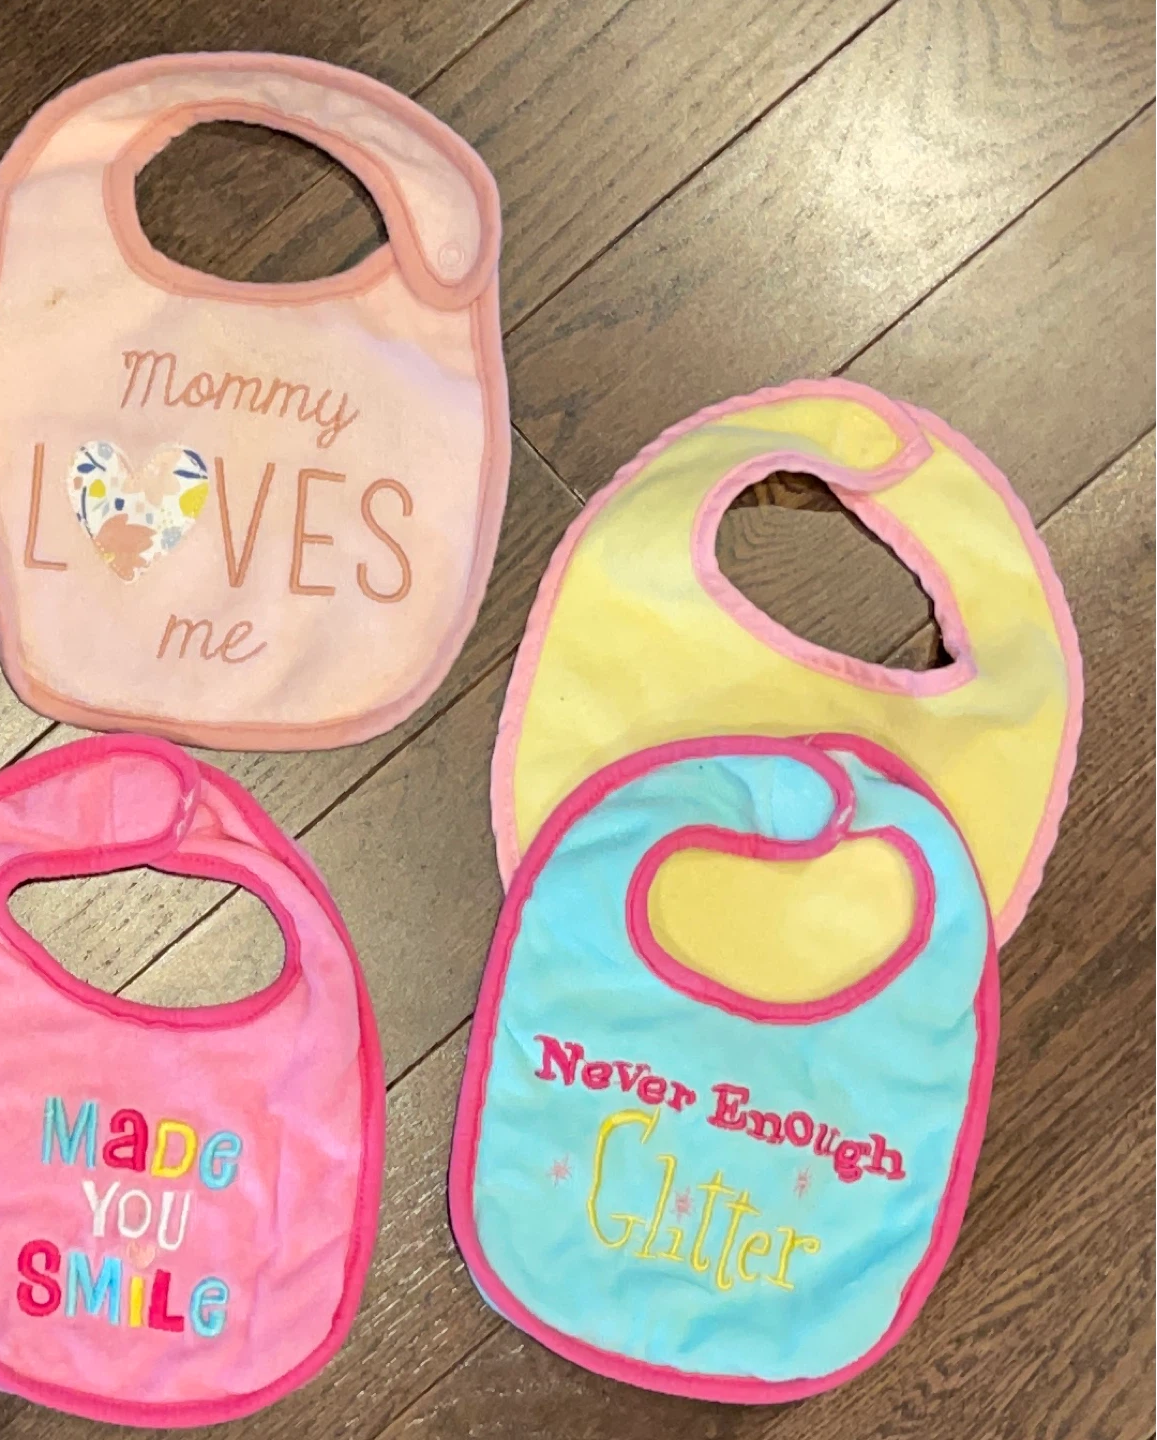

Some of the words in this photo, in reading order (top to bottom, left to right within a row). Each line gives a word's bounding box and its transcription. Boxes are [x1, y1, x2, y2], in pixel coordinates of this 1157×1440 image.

[120, 348, 360, 449] Mommy
[156, 613, 268, 664] me
[533, 1034, 697, 1112] Never
[706, 1082, 907, 1184] Enough
[81, 1179, 192, 1251] YOU
[586, 1106, 822, 1292] Glitter
